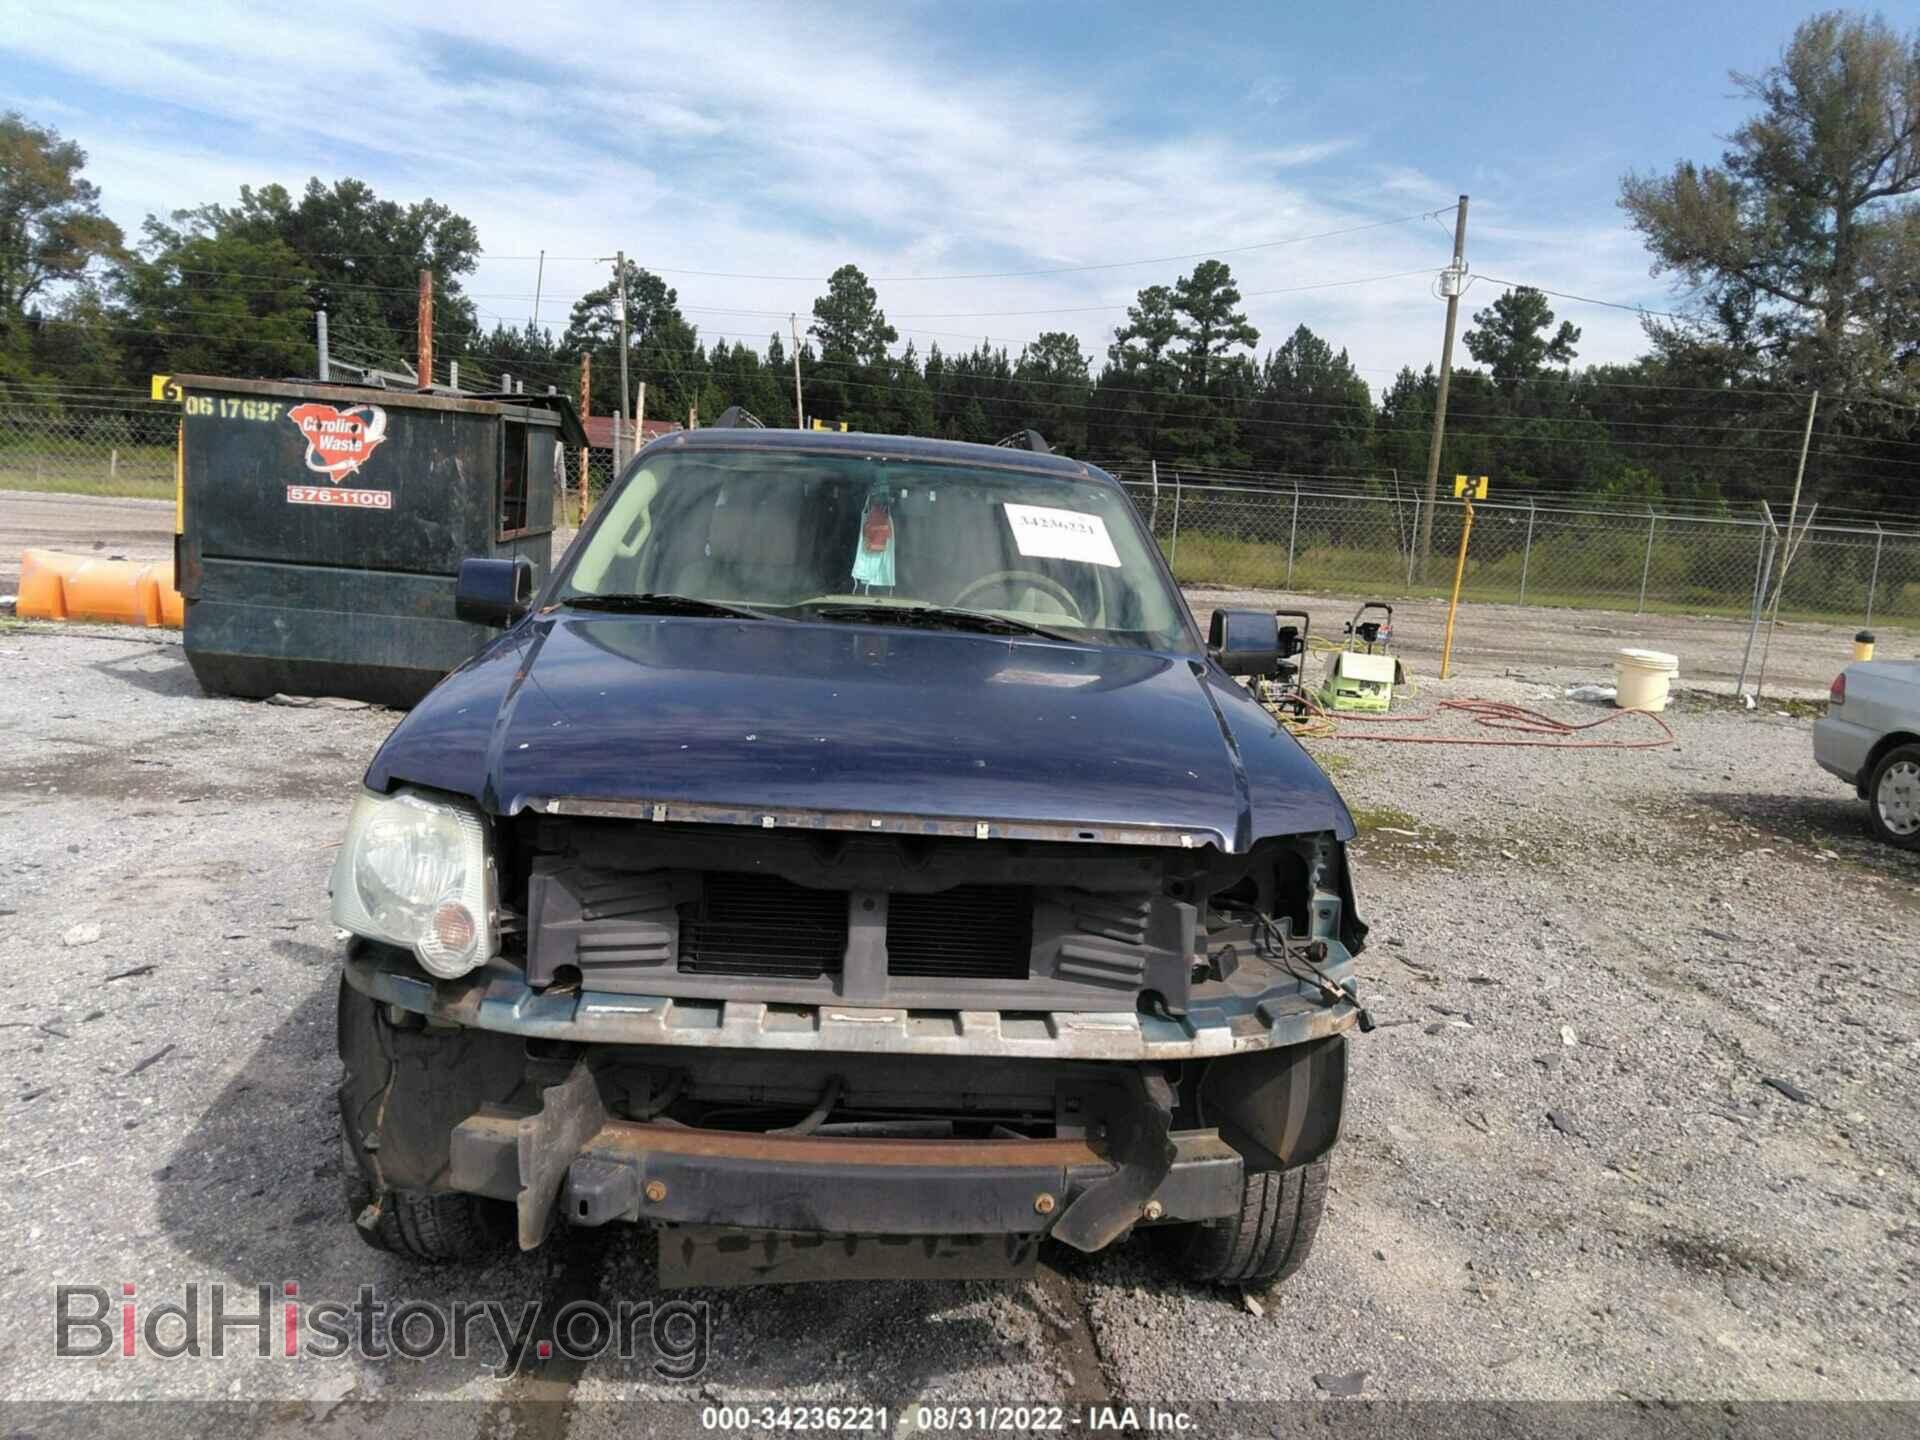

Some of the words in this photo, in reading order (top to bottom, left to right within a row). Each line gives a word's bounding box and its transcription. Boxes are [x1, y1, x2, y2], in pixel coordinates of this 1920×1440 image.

[303, 416, 362, 433] Carolina
[320, 434, 363, 453] Waste
[1461, 475, 1481, 498] 8
[291, 488, 388, 506] 576-1100
